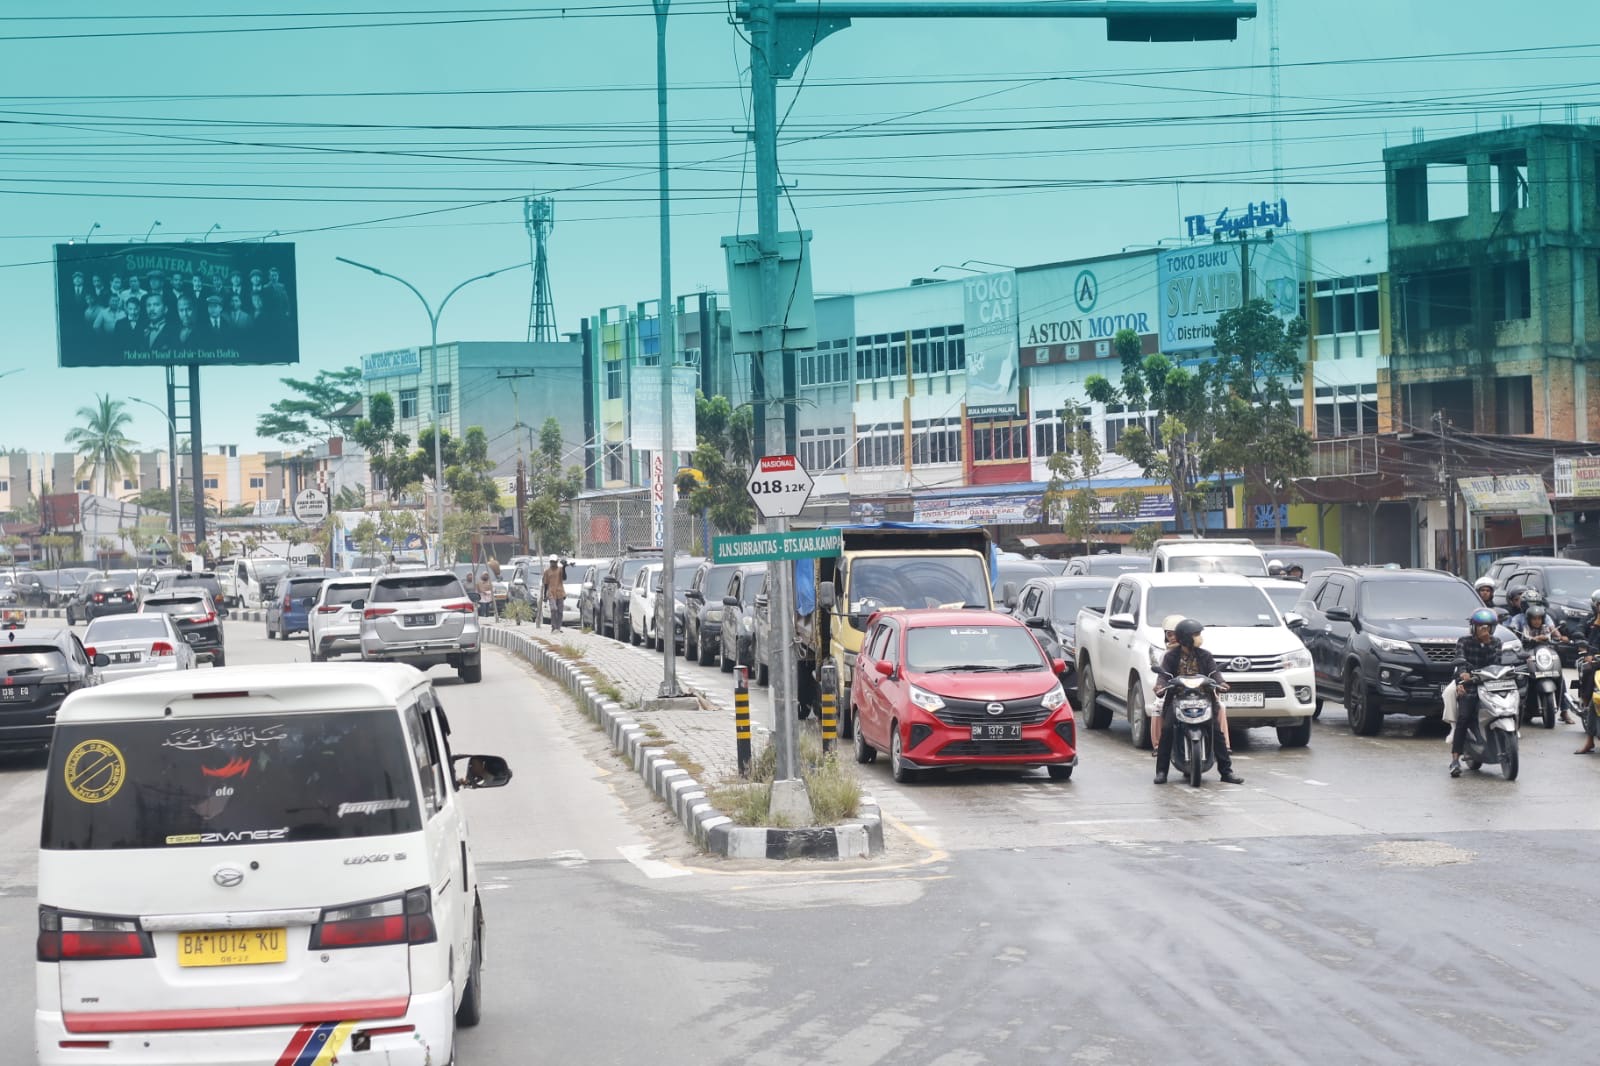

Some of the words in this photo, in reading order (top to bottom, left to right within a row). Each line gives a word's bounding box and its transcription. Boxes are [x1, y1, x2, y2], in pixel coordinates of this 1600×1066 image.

[1184, 214, 1211, 237] TB.
[126, 254, 193, 273] SUMATERA
[200, 259, 229, 279] SATU
[1166, 255, 1195, 272] TOKO
[1198, 250, 1229, 268] BUKU
[965, 276, 1013, 302] TOKO
[1167, 271, 1257, 318] SYAHB
[979, 299, 1012, 323] CAT
[1027, 319, 1083, 345] ASTON
[1088, 312, 1150, 338] MOTOR
[762, 460, 793, 468] NASIONAL
[655, 456, 664, 501] ASTON
[751, 480, 782, 494] 018
[785, 483, 806, 492] 12K
[719, 540, 777, 557] JLN.SUBRANTAS
[784, 536, 844, 553] BTS.KAB.KAMPA
[988, 726, 1004, 735] 1373
[184, 936, 203, 955] BA
[210, 932, 247, 954] 1014
[259, 932, 279, 951] KU
